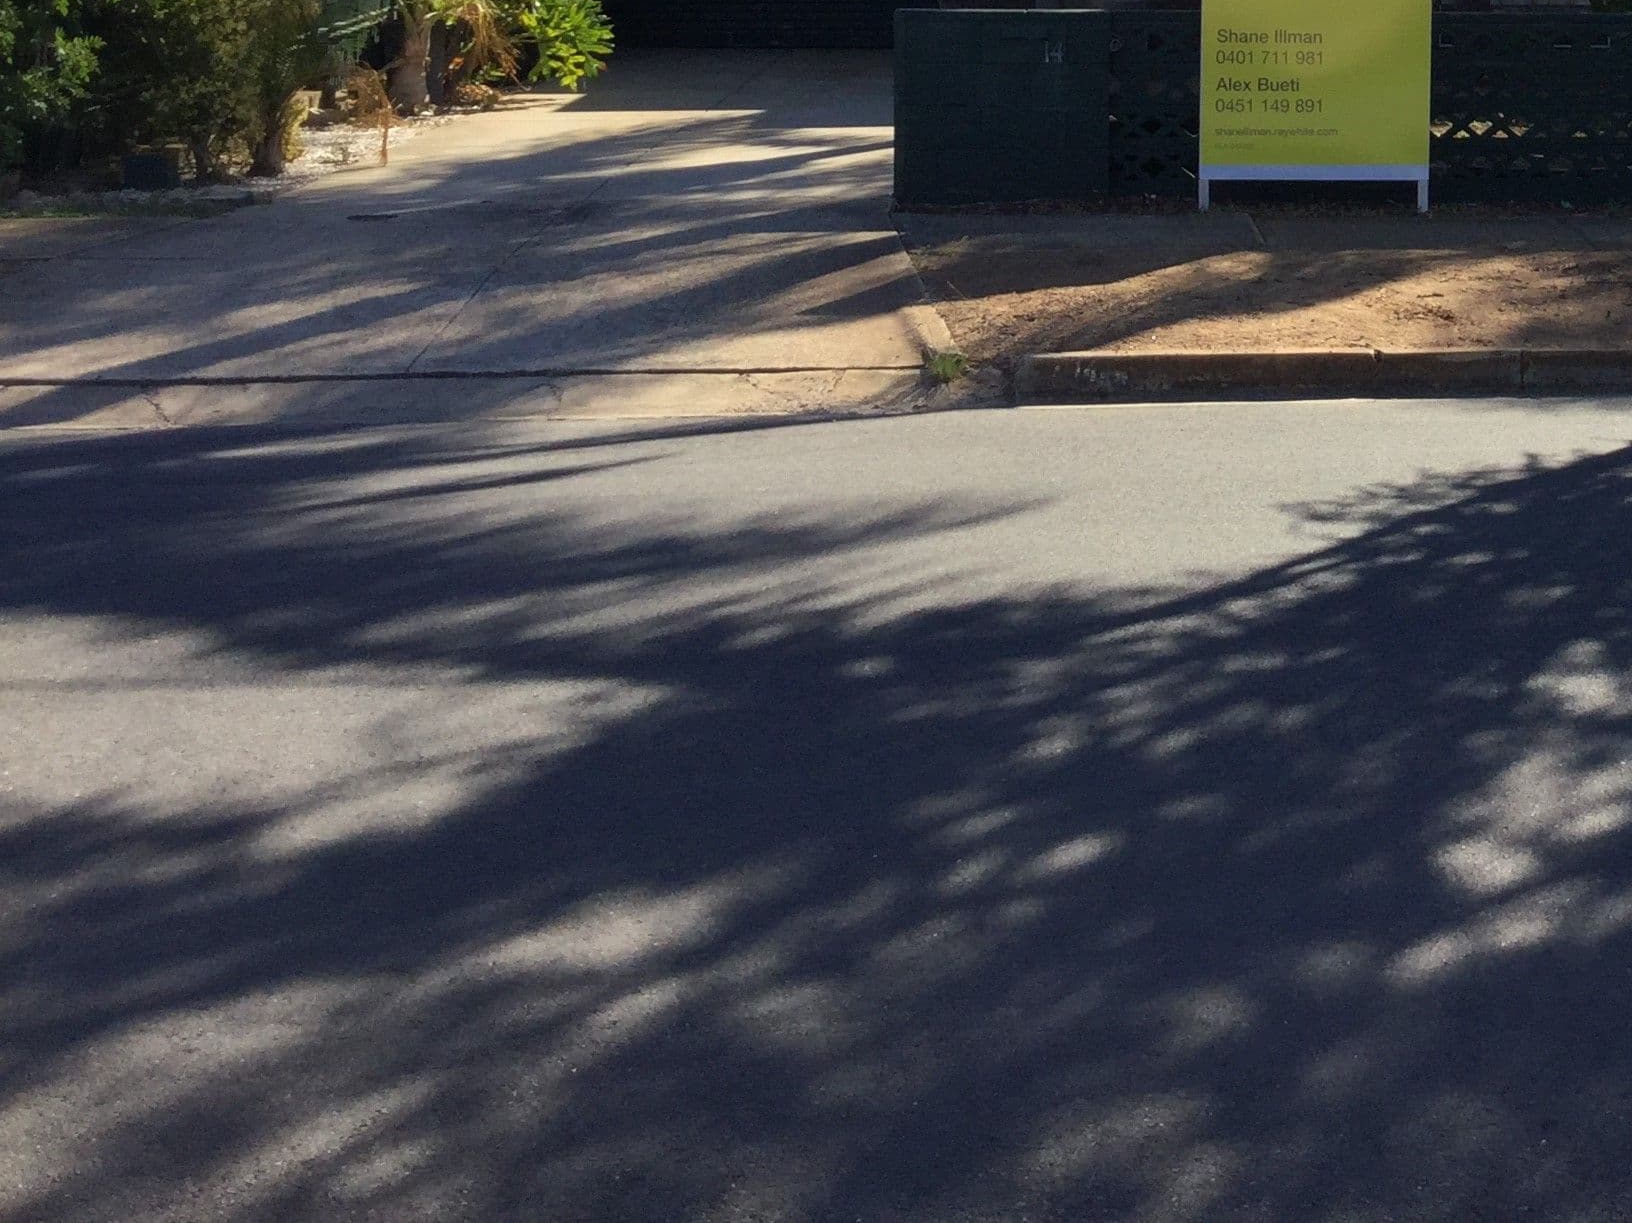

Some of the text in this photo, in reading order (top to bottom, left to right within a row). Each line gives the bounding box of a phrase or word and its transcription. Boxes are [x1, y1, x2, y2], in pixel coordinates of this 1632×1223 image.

[1217, 29, 1323, 44] Shane Illman
[1216, 50, 1323, 65] 0401 711 981
[1216, 78, 1300, 92] Alex Bueti
[1215, 98, 1323, 113] 0451 149 891
